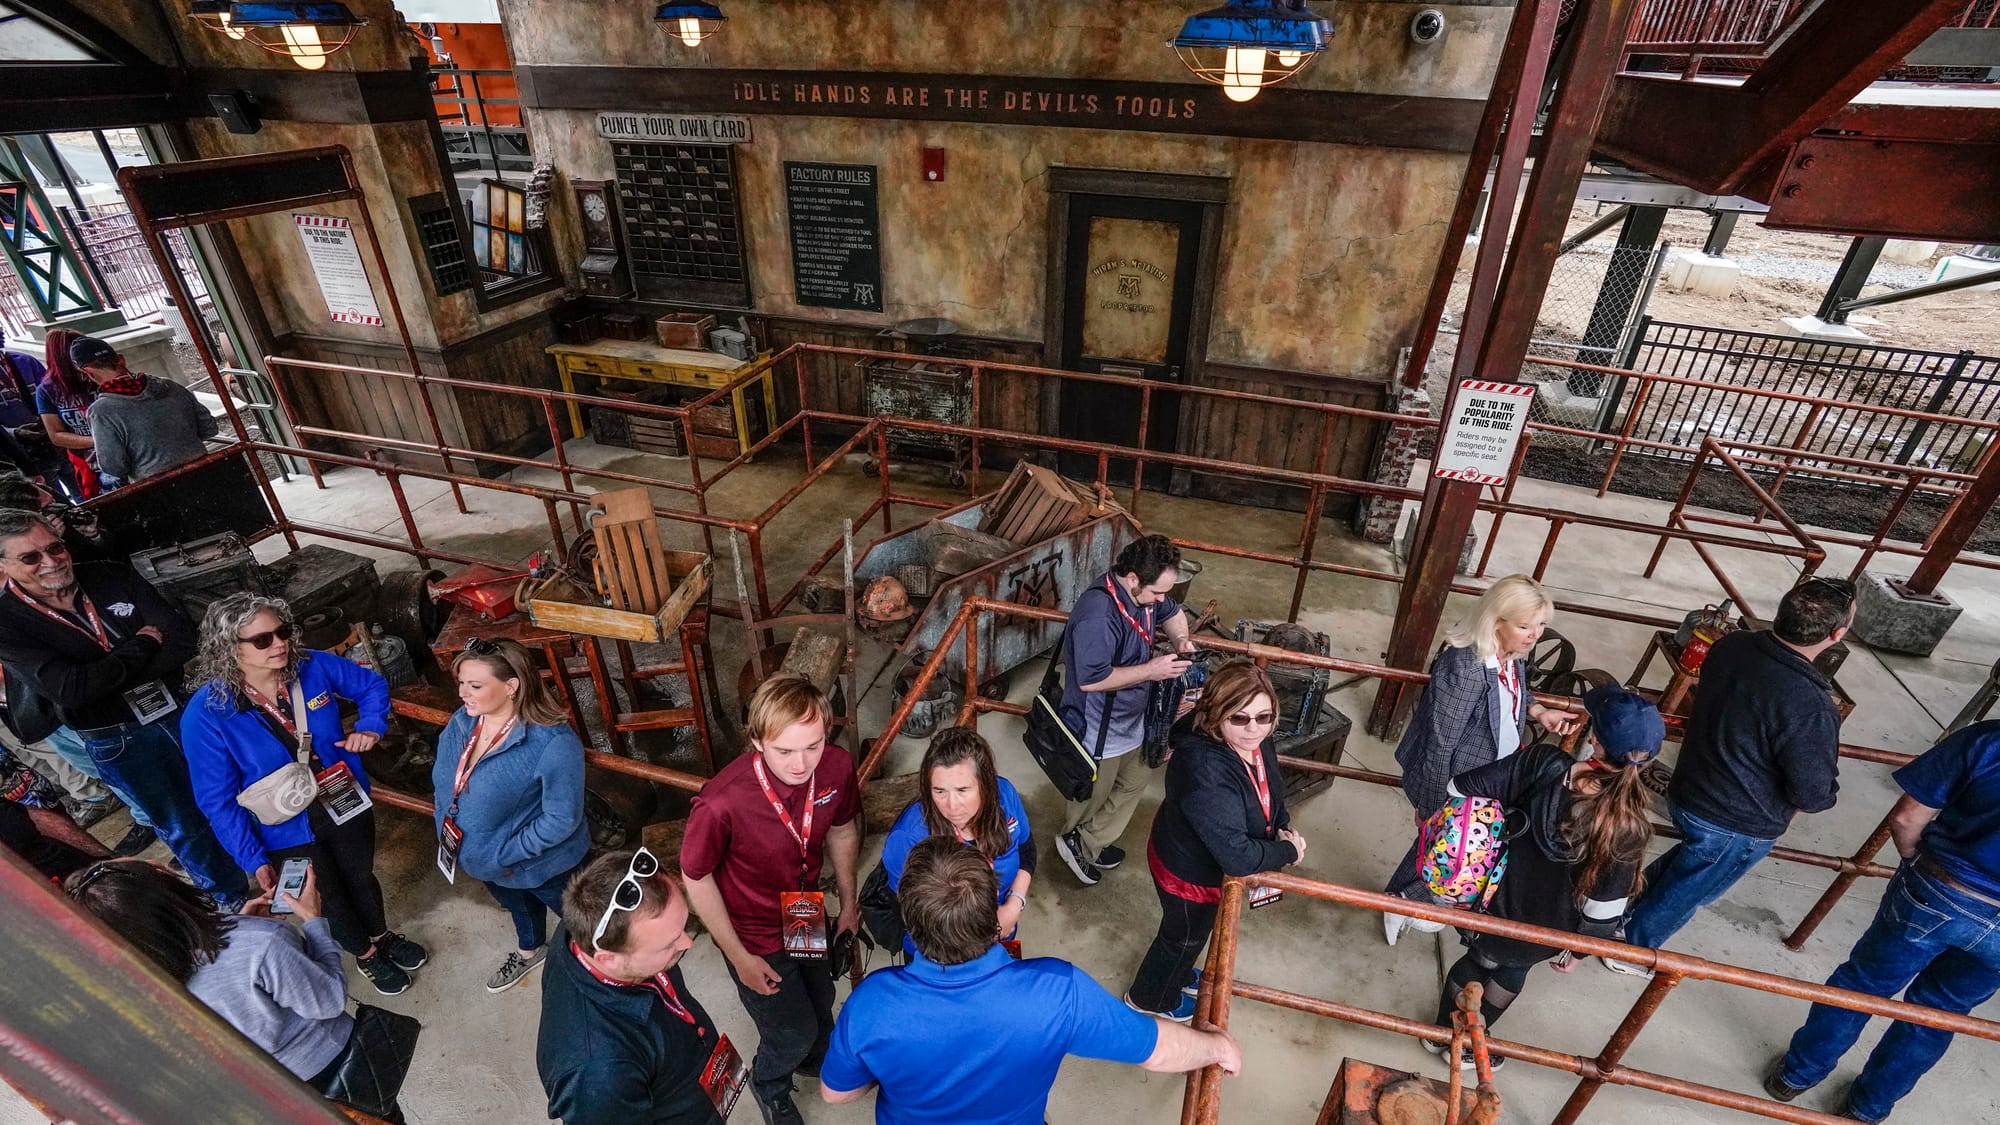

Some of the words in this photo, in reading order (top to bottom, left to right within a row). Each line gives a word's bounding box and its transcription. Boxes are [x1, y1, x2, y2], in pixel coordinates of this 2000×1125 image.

[734, 83, 780, 101] IDLE
[794, 84, 870, 104] HANDS
[885, 87, 928, 106] ARE
[944, 88, 989, 109] THE
[1004, 91, 1098, 114] DEVIL'S
[1115, 95, 1196, 119] TOOLS
[600, 116, 638, 136] PUNCH
[641, 117, 676, 137] YOUR
[680, 118, 709, 138] OWN
[713, 119, 746, 139] CARD
[790, 167, 835, 181] FACTORY
[837, 170, 871, 183] RULES
[320, 229, 329, 237] THE
[1469, 398, 1487, 408] DUE
[1488, 400, 1499, 410] TO
[1500, 402, 1516, 412] THE
[1464, 407, 1515, 422] POPULARITY
[1459, 416, 1471, 426] OF
[1472, 417, 1490, 428] THIS
[1491, 420, 1513, 431] RIDE:
[1456, 430, 1480, 441] Riders
[1481, 435, 1497, 444] may
[1497, 435, 1507, 445] be
[1455, 440, 1487, 450] assigned
[1488, 444, 1496, 452] to
[1453, 449, 1480, 459] specific
[755, 760, 764, 781] Dorney
[762, 779, 770, 790] Park
